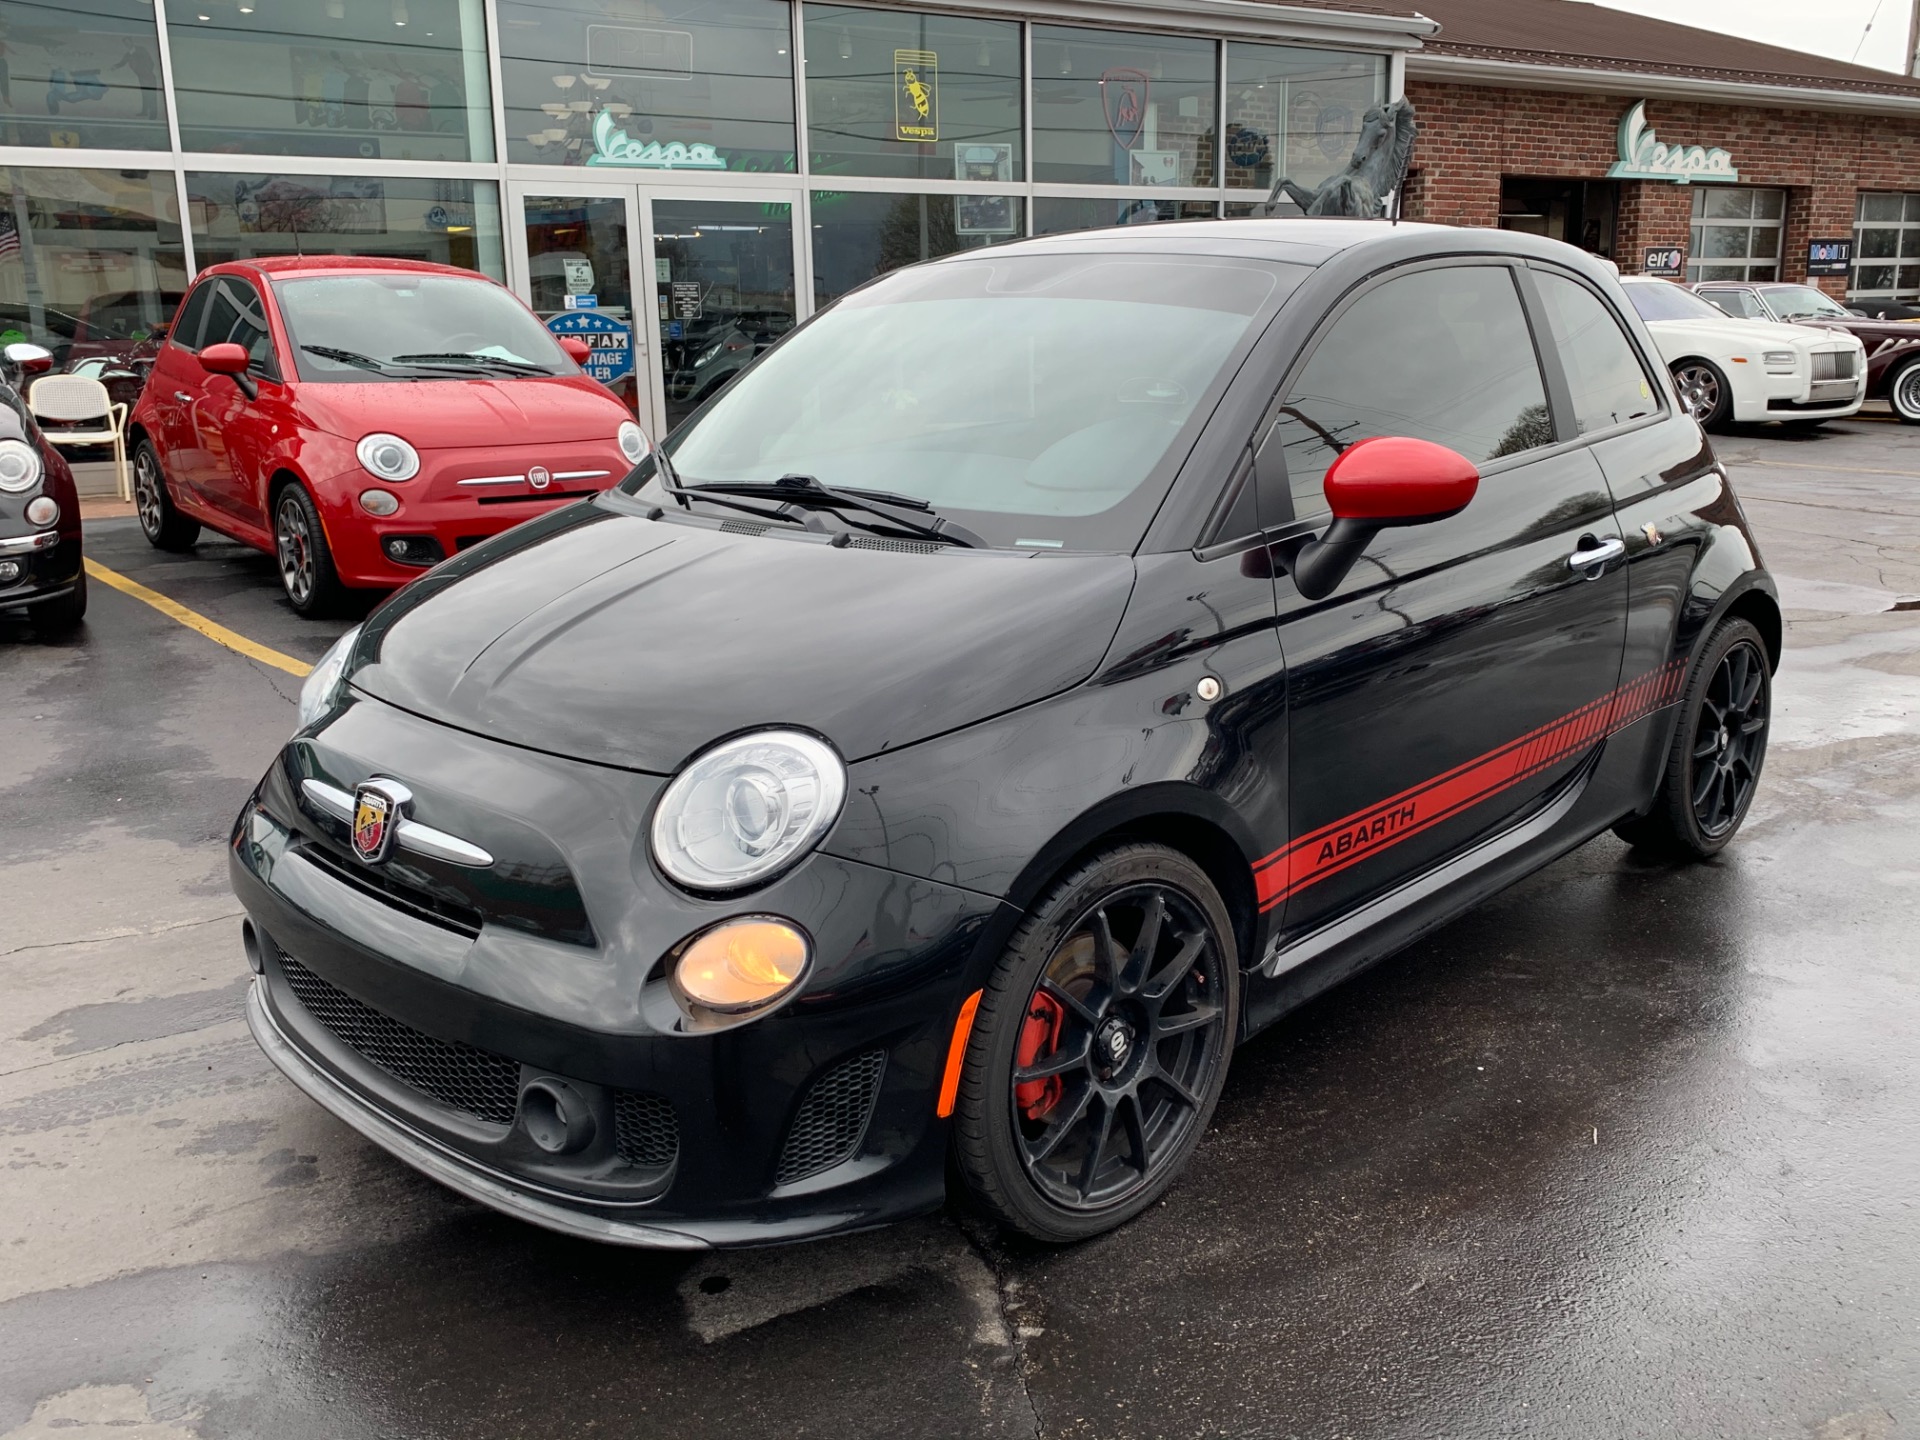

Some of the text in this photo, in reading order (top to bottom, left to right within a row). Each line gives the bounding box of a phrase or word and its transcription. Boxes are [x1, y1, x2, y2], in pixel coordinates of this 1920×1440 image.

[592, 31, 688, 74] OPEN
[594, 108, 724, 169] Vespa
[900, 126, 935, 137] Vespa
[1617, 99, 1736, 181] Vespa
[1647, 252, 1669, 267] elf
[1811, 245, 1838, 259] Mobil
[1316, 802, 1416, 865] ABARTH
